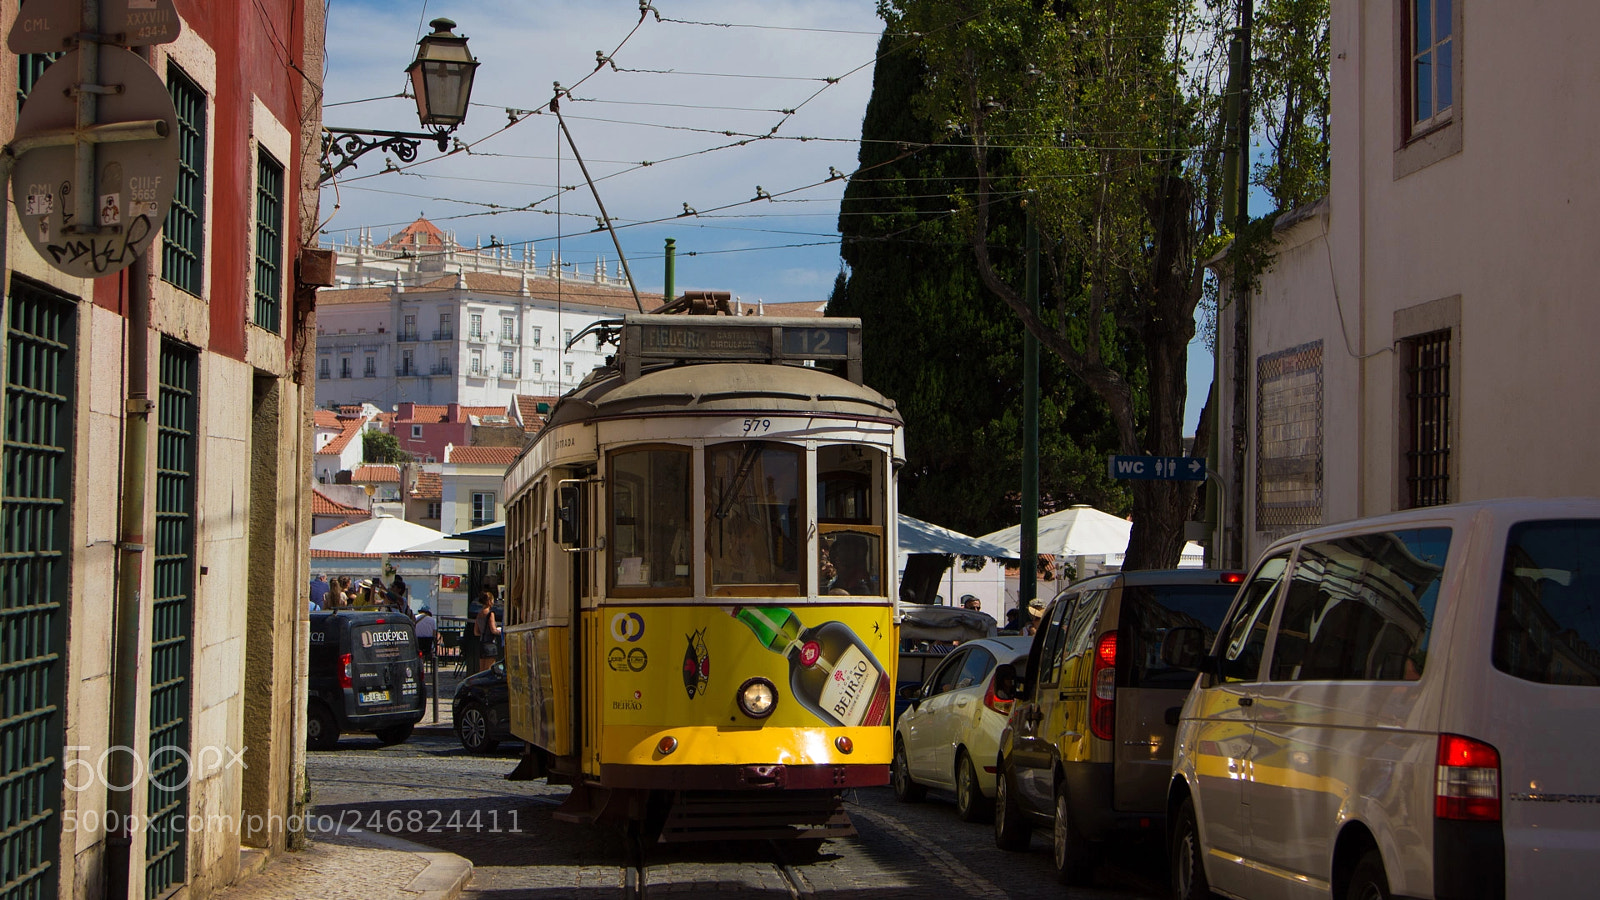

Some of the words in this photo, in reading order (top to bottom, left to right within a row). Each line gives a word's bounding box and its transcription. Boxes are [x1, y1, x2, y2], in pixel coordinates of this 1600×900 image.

[23, 18, 50, 32] CML
[126, 9, 170, 27] XXXVIII
[137, 24, 168, 38] 434-A
[129, 176, 162, 190] CIII-F
[131, 188, 157, 201] 5663
[799, 329, 832, 354] 12
[743, 418, 771, 433] 579
[1117, 461, 1145, 475] WC
[833, 660, 867, 717] BEIRÃO
